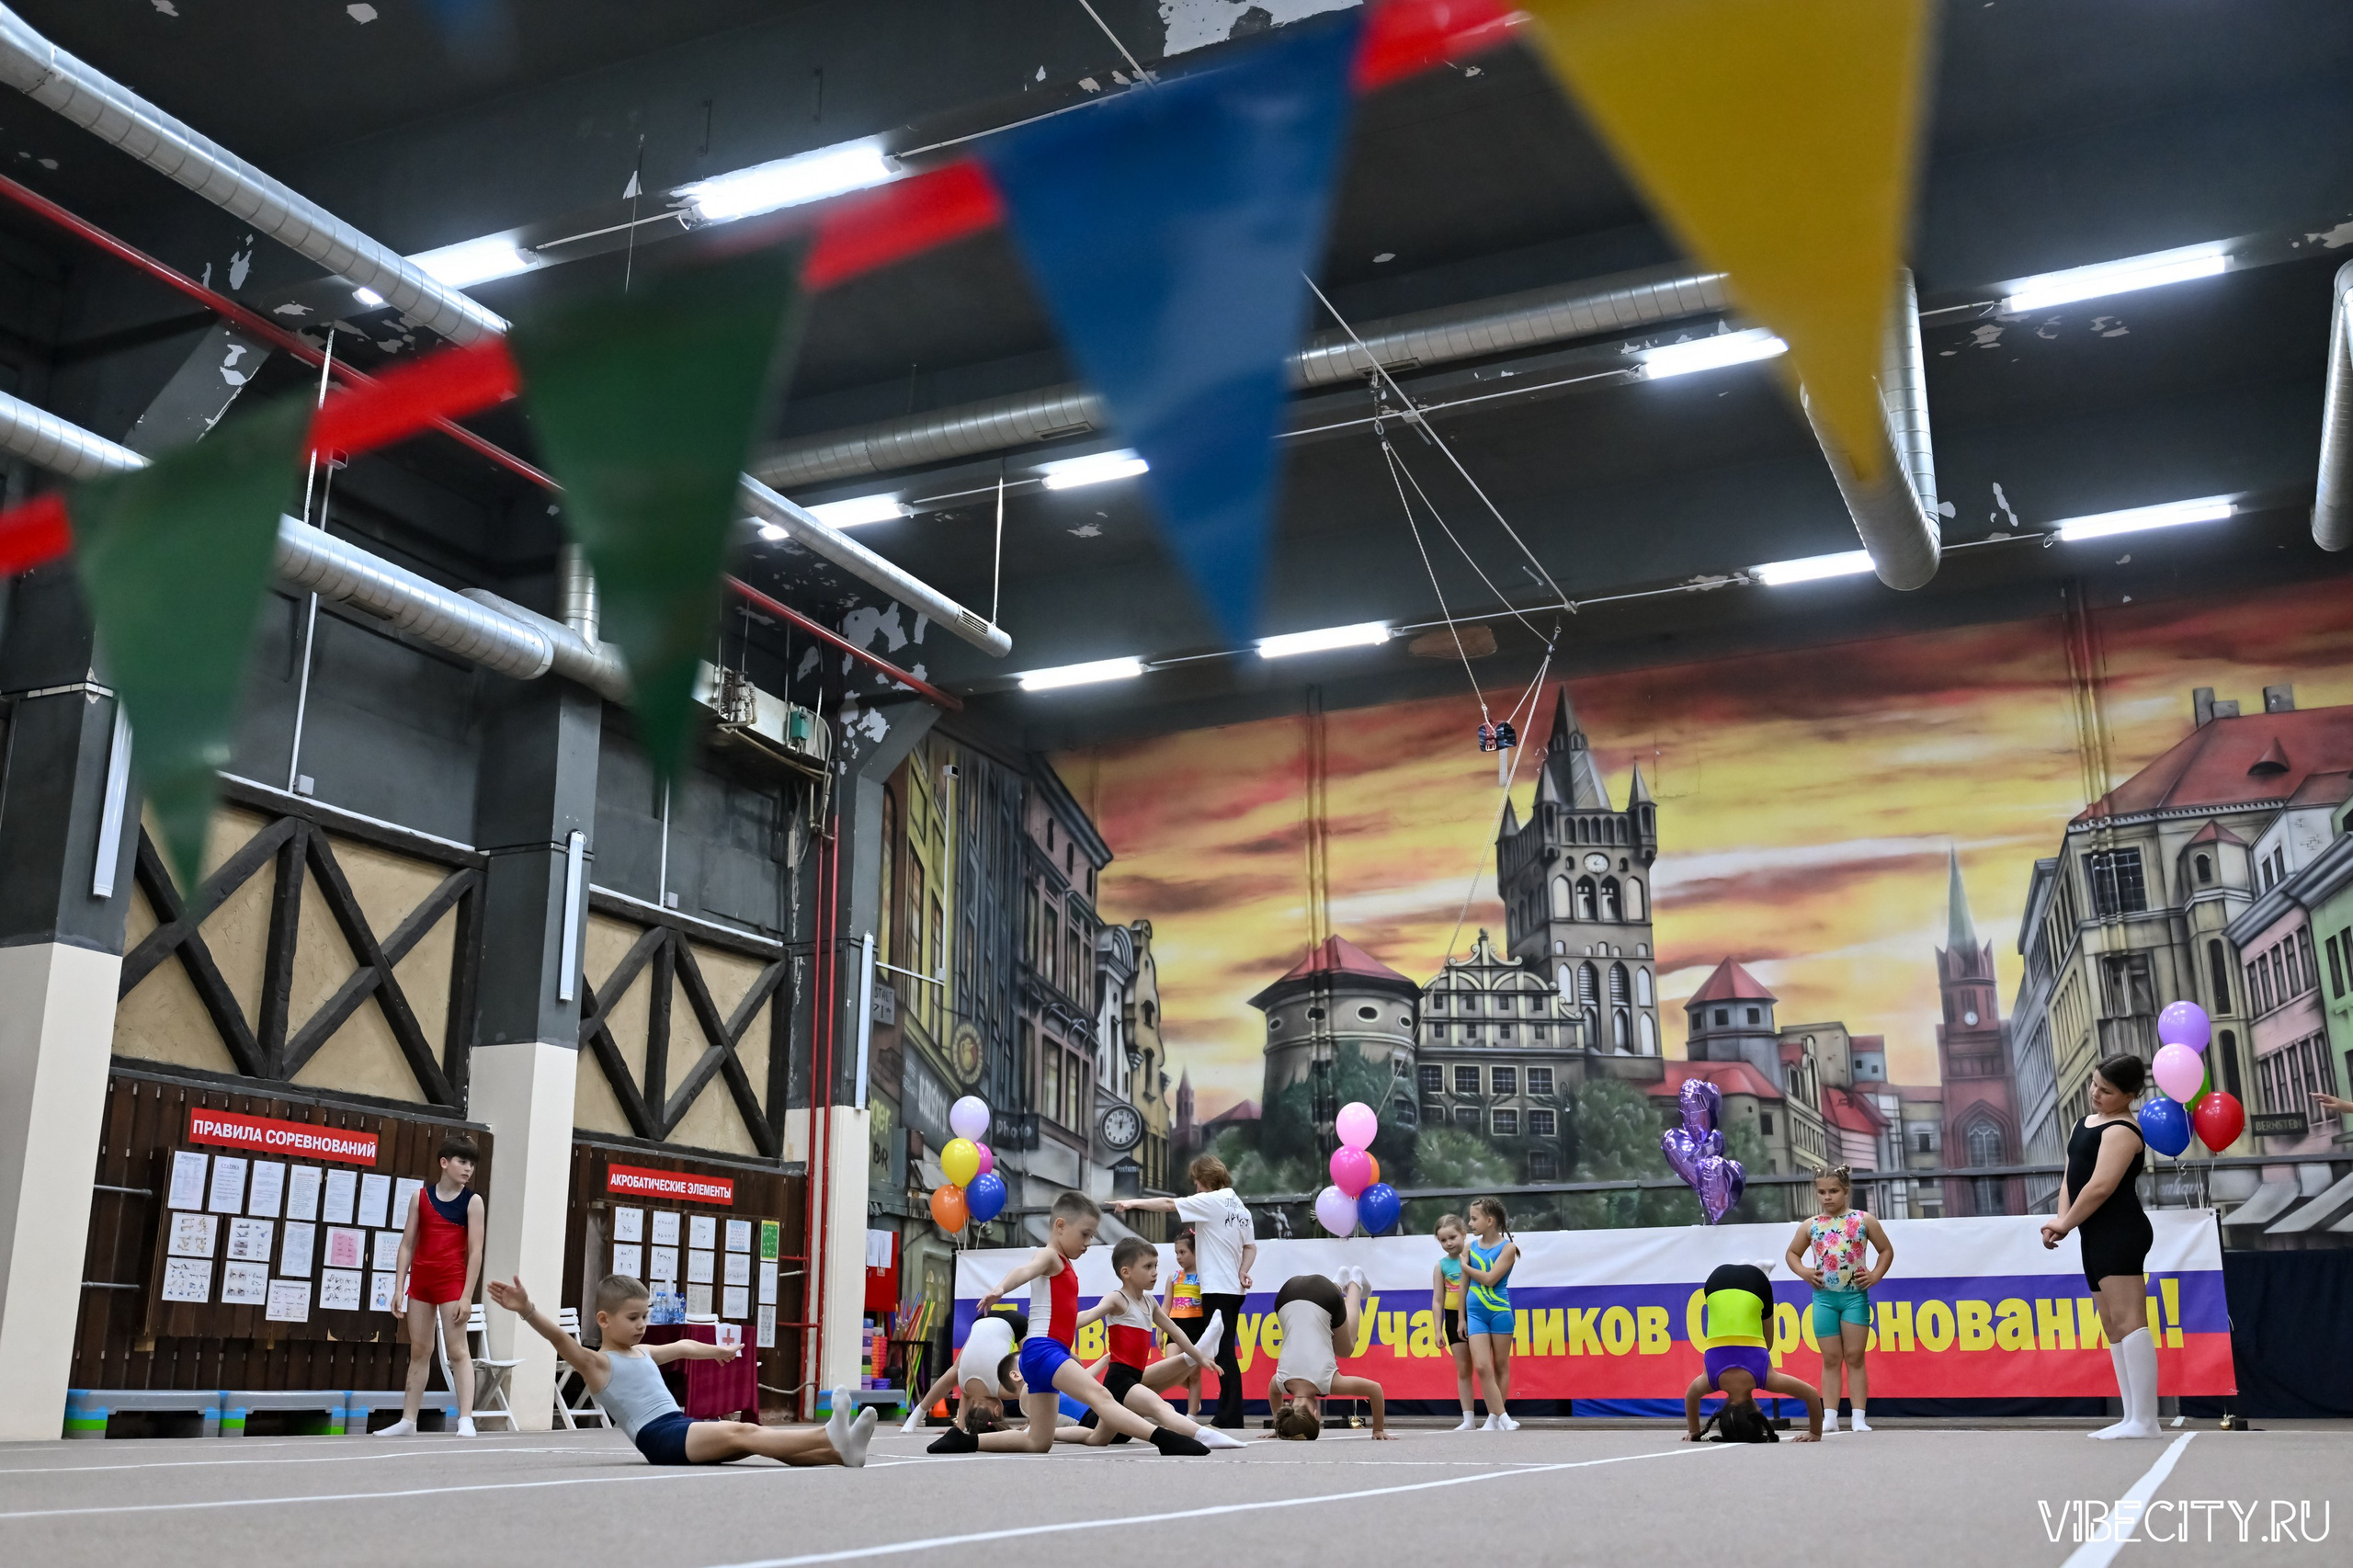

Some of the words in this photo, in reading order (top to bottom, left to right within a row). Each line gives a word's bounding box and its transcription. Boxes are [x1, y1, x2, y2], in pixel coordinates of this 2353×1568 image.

[870, 1096, 892, 1136] ger
[995, 1119, 1033, 1139] Photo
[2255, 1118, 2302, 1131] BERNSTEIN
[192, 1119, 262, 1142] ПРАВИЛА
[266, 1129, 376, 1158] СОРЕВНОВАНИЙ
[610, 1173, 687, 1194] АКРОБАТИЧЕСКИЕ
[687, 1182, 732, 1199] ЭЛЕМЕНТЫ
